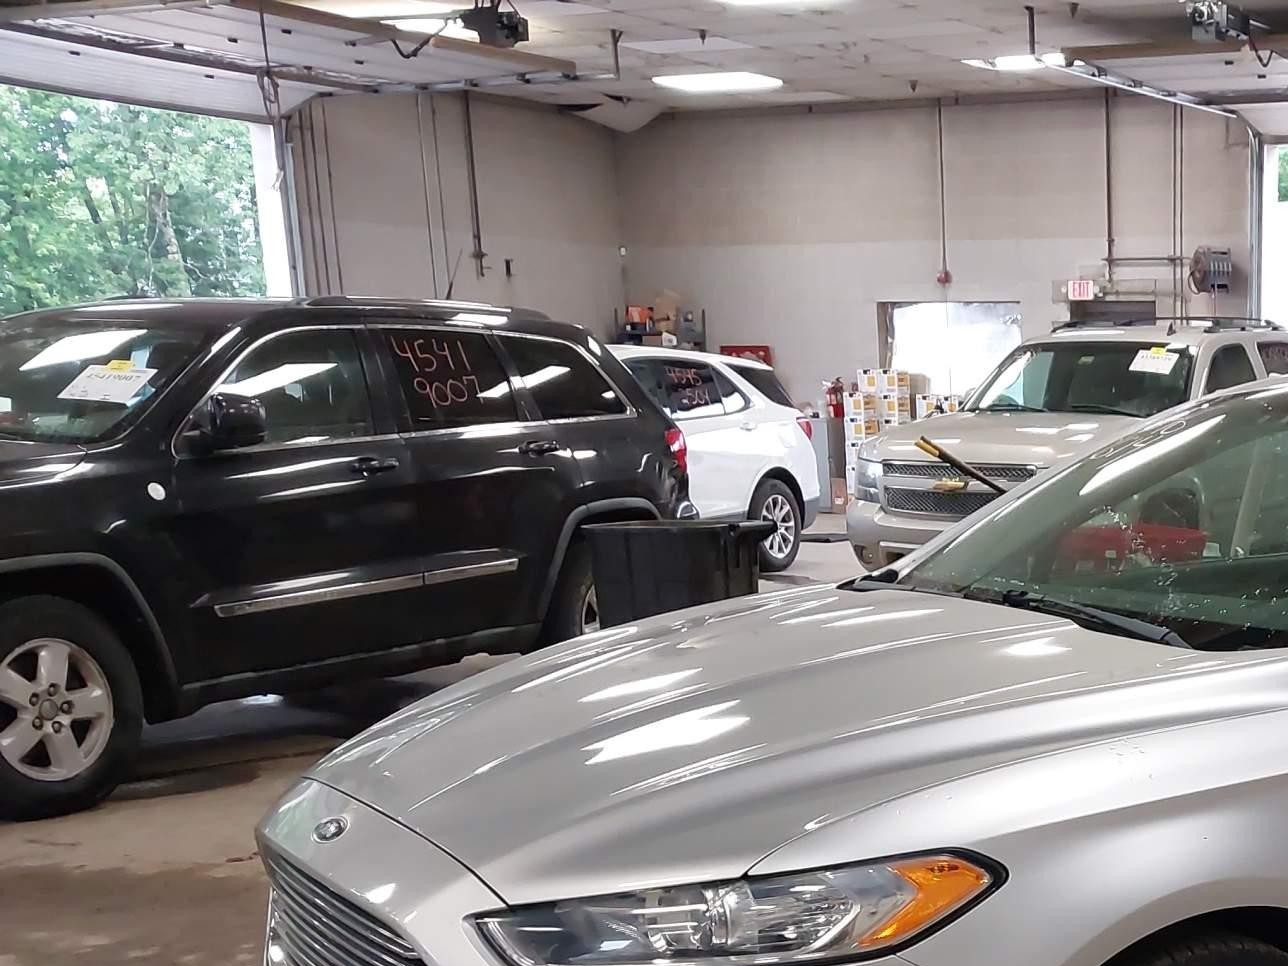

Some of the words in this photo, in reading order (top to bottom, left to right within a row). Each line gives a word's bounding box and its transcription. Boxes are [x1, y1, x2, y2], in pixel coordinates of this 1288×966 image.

[1072, 281, 1089, 298] EXIT
[390, 335, 471, 372] 4541
[414, 377, 484, 408] 9007
